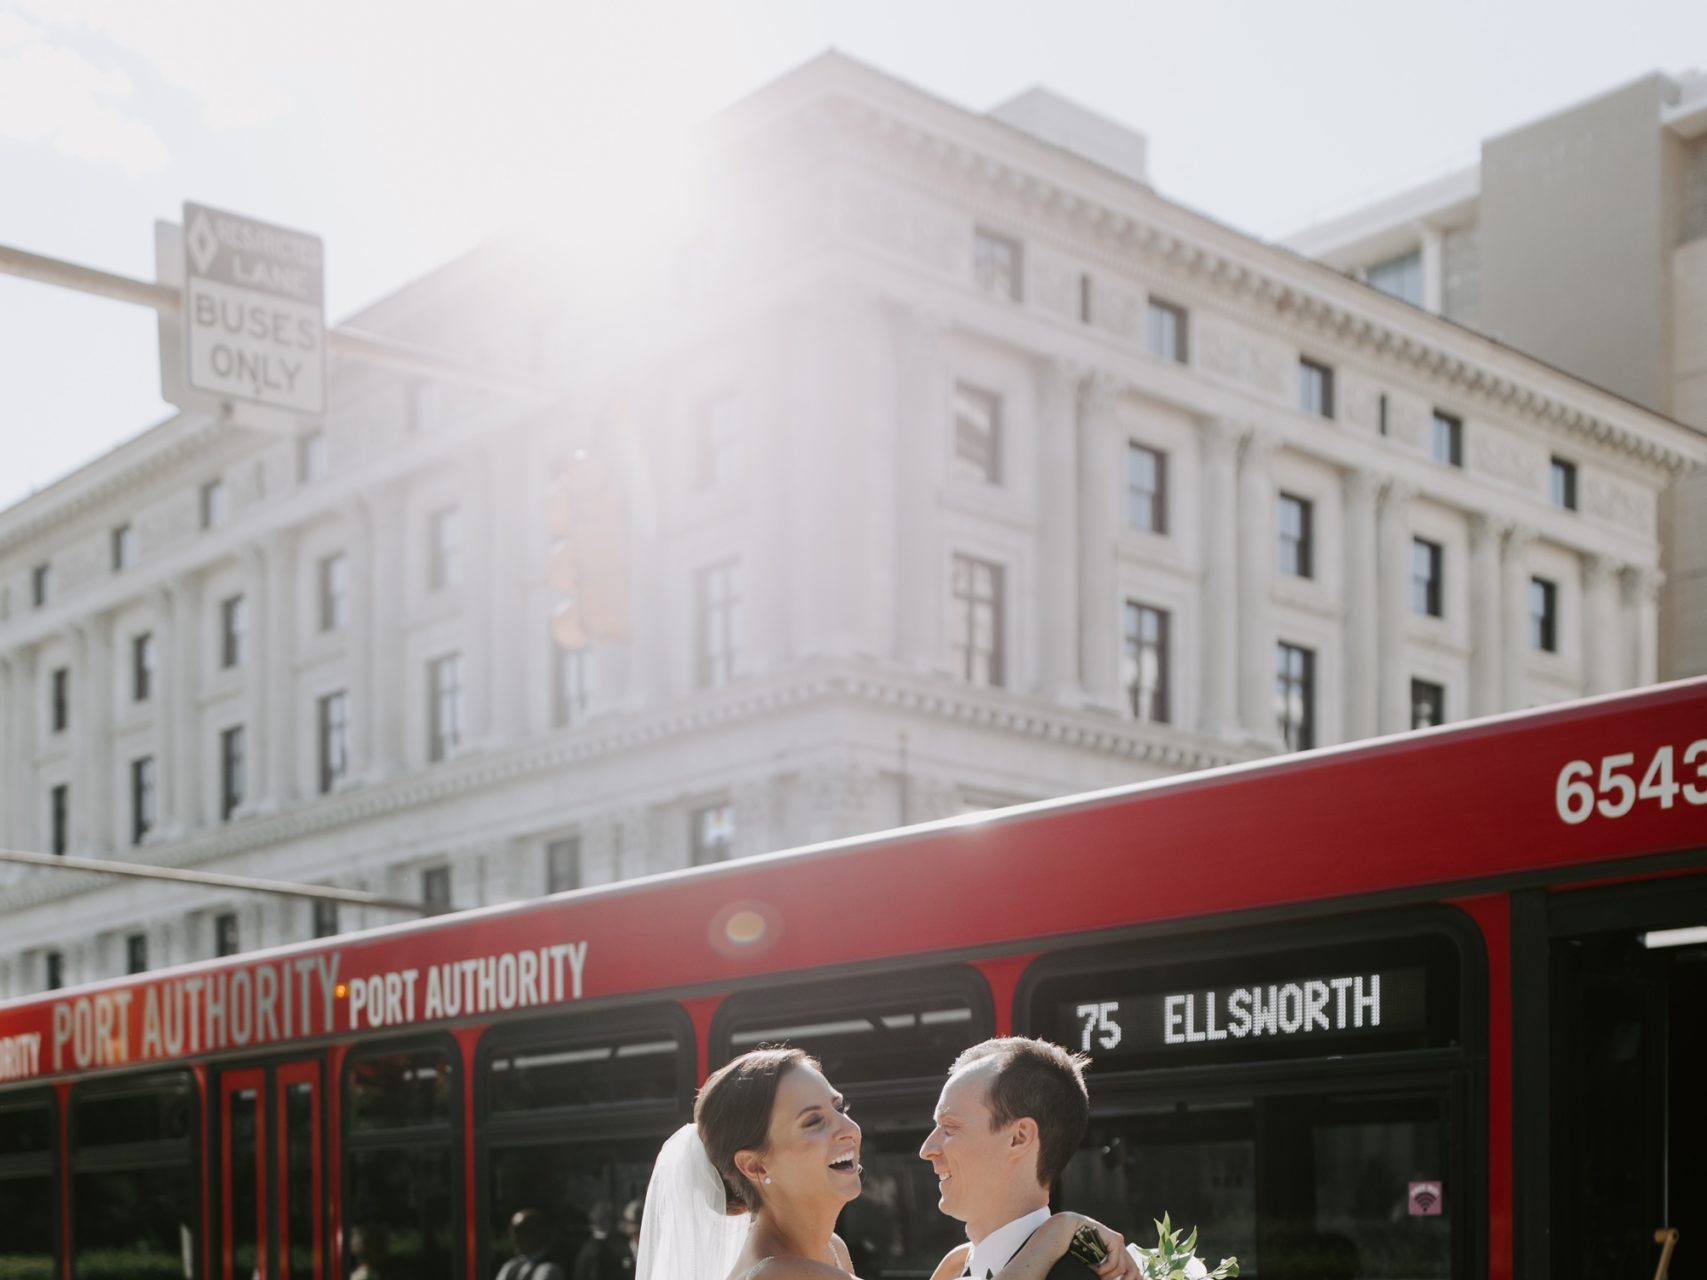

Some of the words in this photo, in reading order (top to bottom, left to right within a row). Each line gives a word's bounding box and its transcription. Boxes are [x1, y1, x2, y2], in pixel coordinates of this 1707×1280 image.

[233, 254, 307, 297] LANE
[196, 294, 315, 351] BUSES
[210, 343, 302, 392] ONLY
[1555, 738, 1707, 825] 6543
[53, 991, 132, 1071] PORT
[143, 953, 340, 1056] AUTHORITY
[350, 969, 417, 1029] PORT
[425, 941, 588, 1018] AUTHORITY
[1076, 1002, 1121, 1051] 75
[1164, 974, 1380, 1045] ELLSWORTH
